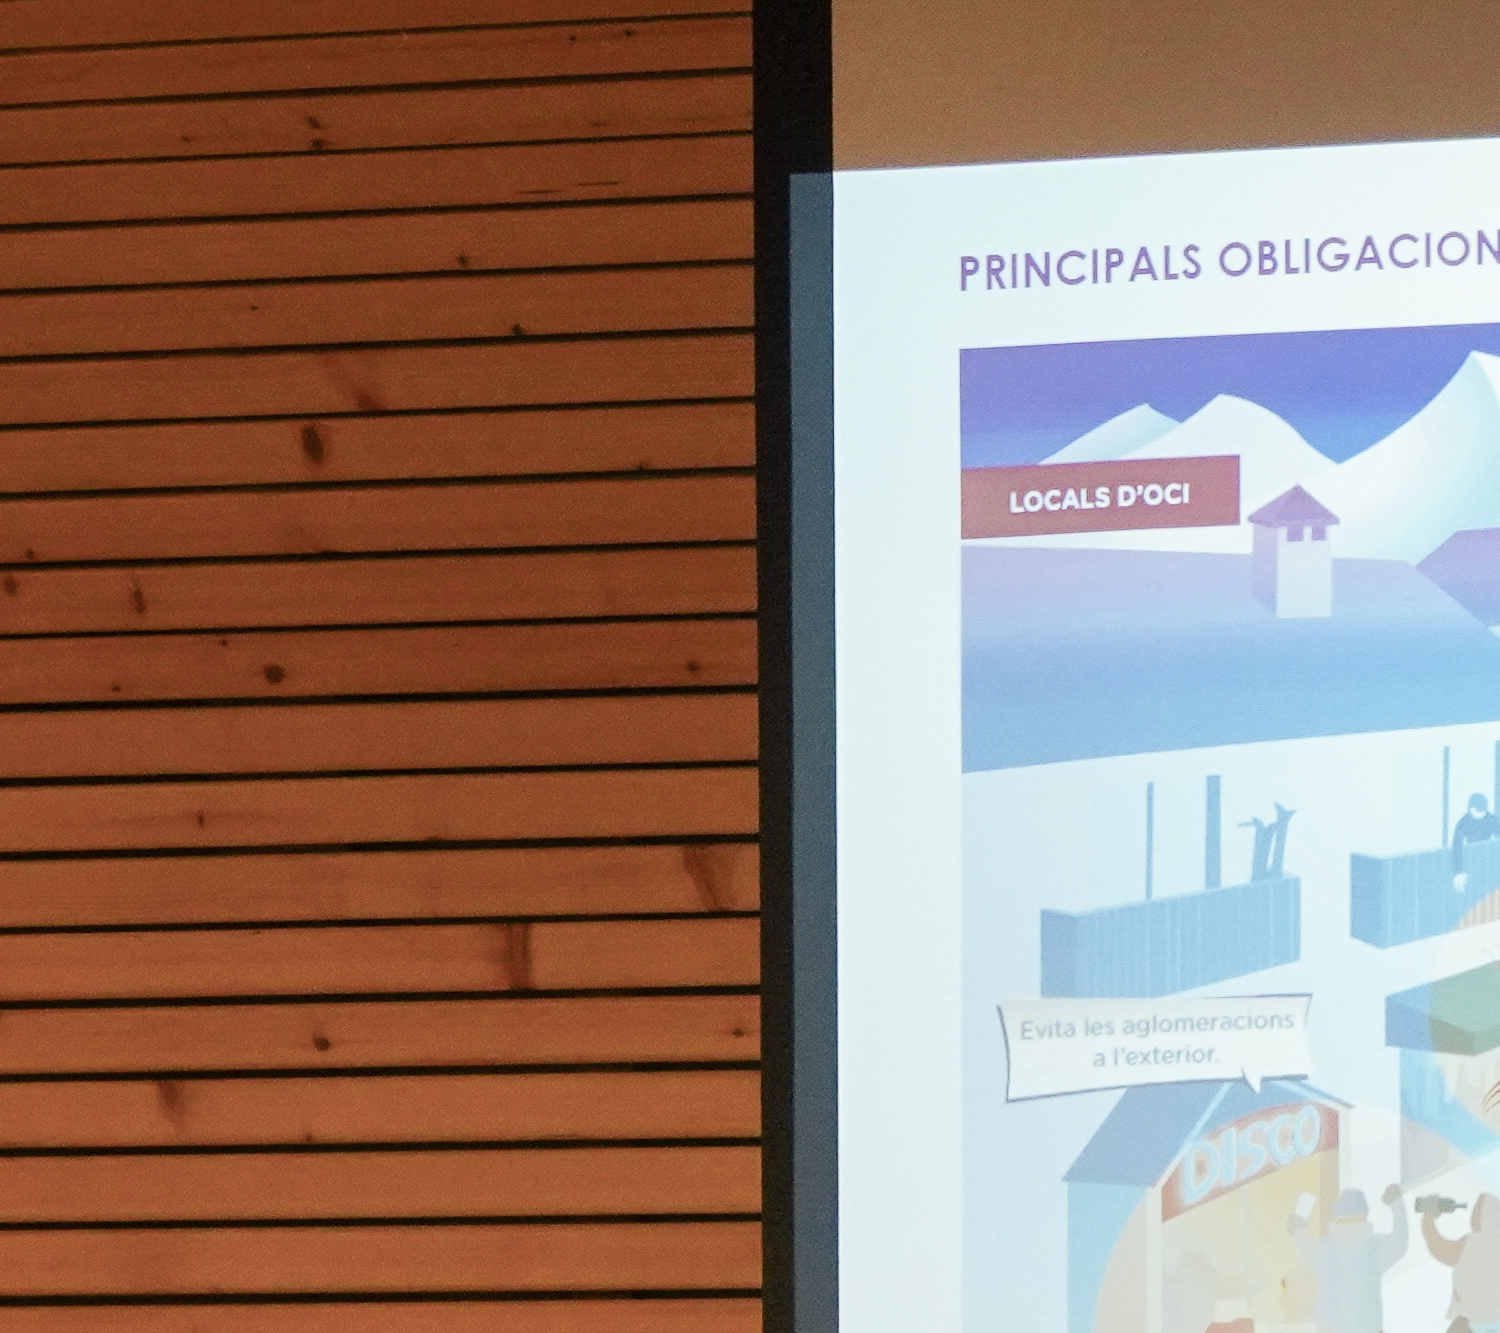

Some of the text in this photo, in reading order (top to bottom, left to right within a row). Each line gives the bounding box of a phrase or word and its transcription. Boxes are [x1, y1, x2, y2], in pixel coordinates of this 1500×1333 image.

[960, 243, 1203, 294] PRINCIPALS
[1010, 483, 1191, 516] LOCALS D'OCI
[1019, 1010, 1297, 1043] Evita les aglomeracions
[1092, 1047, 1221, 1070] a l'exterior.
[1182, 1104, 1322, 1205] DISCO
